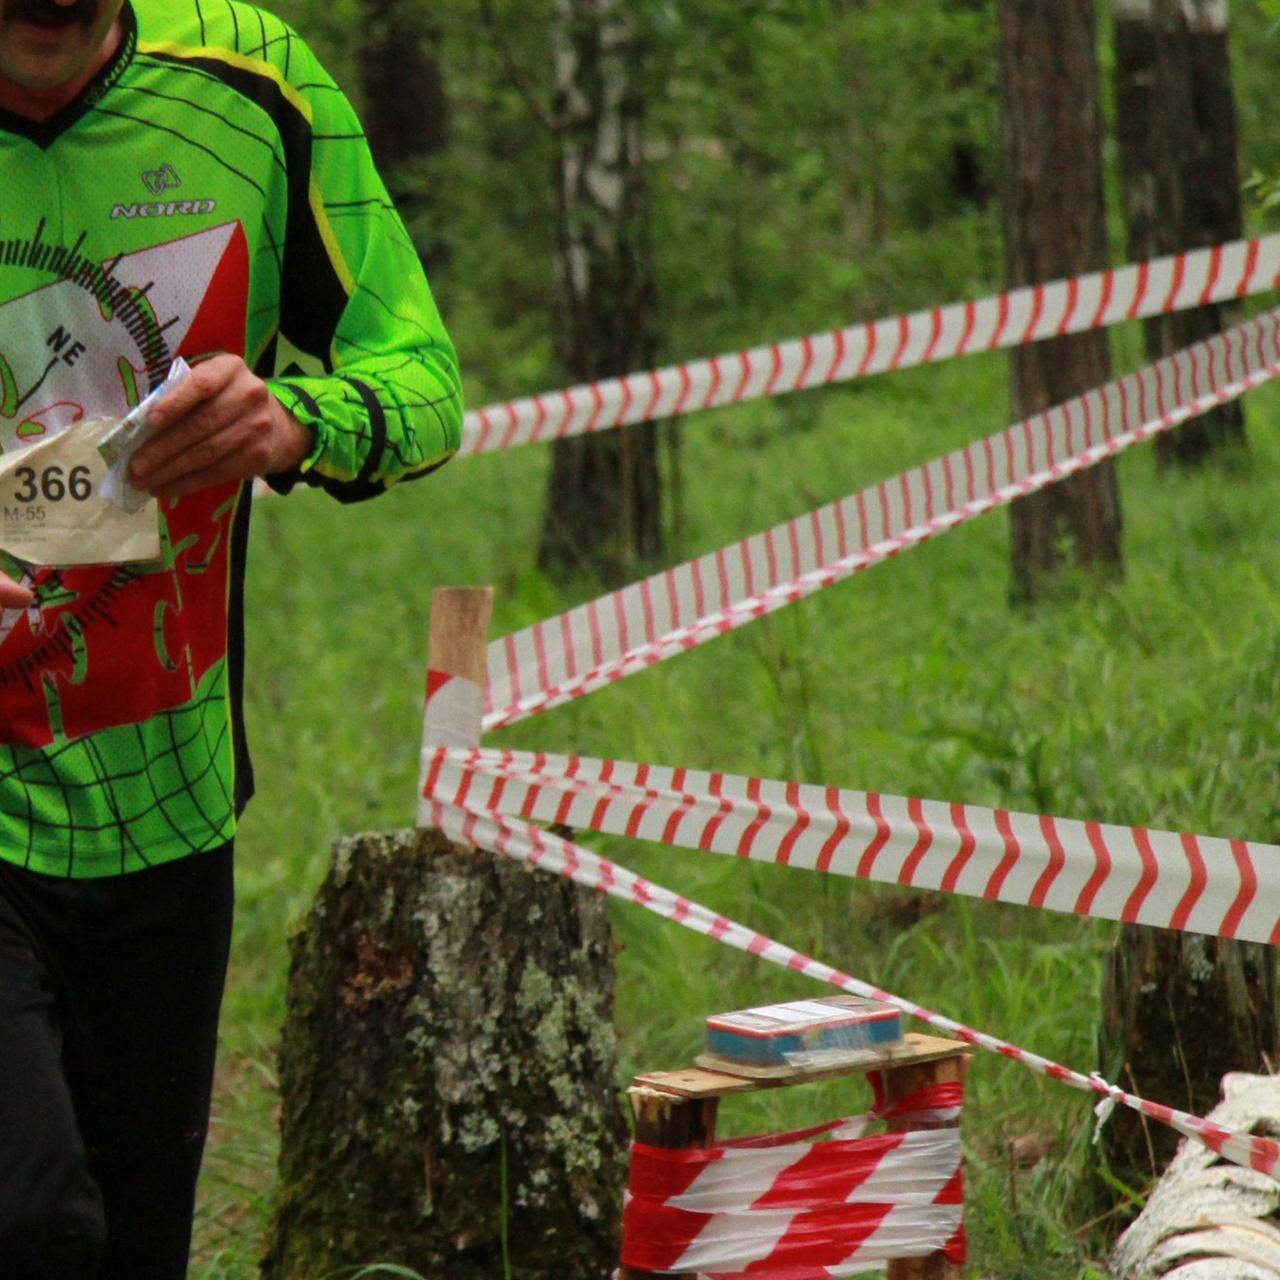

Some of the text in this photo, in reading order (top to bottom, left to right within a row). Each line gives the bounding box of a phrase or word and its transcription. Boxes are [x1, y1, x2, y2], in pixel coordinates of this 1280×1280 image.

[110, 198, 217, 219] NORD
[46, 325, 86, 367] NE
[14, 465, 92, 503] 366
